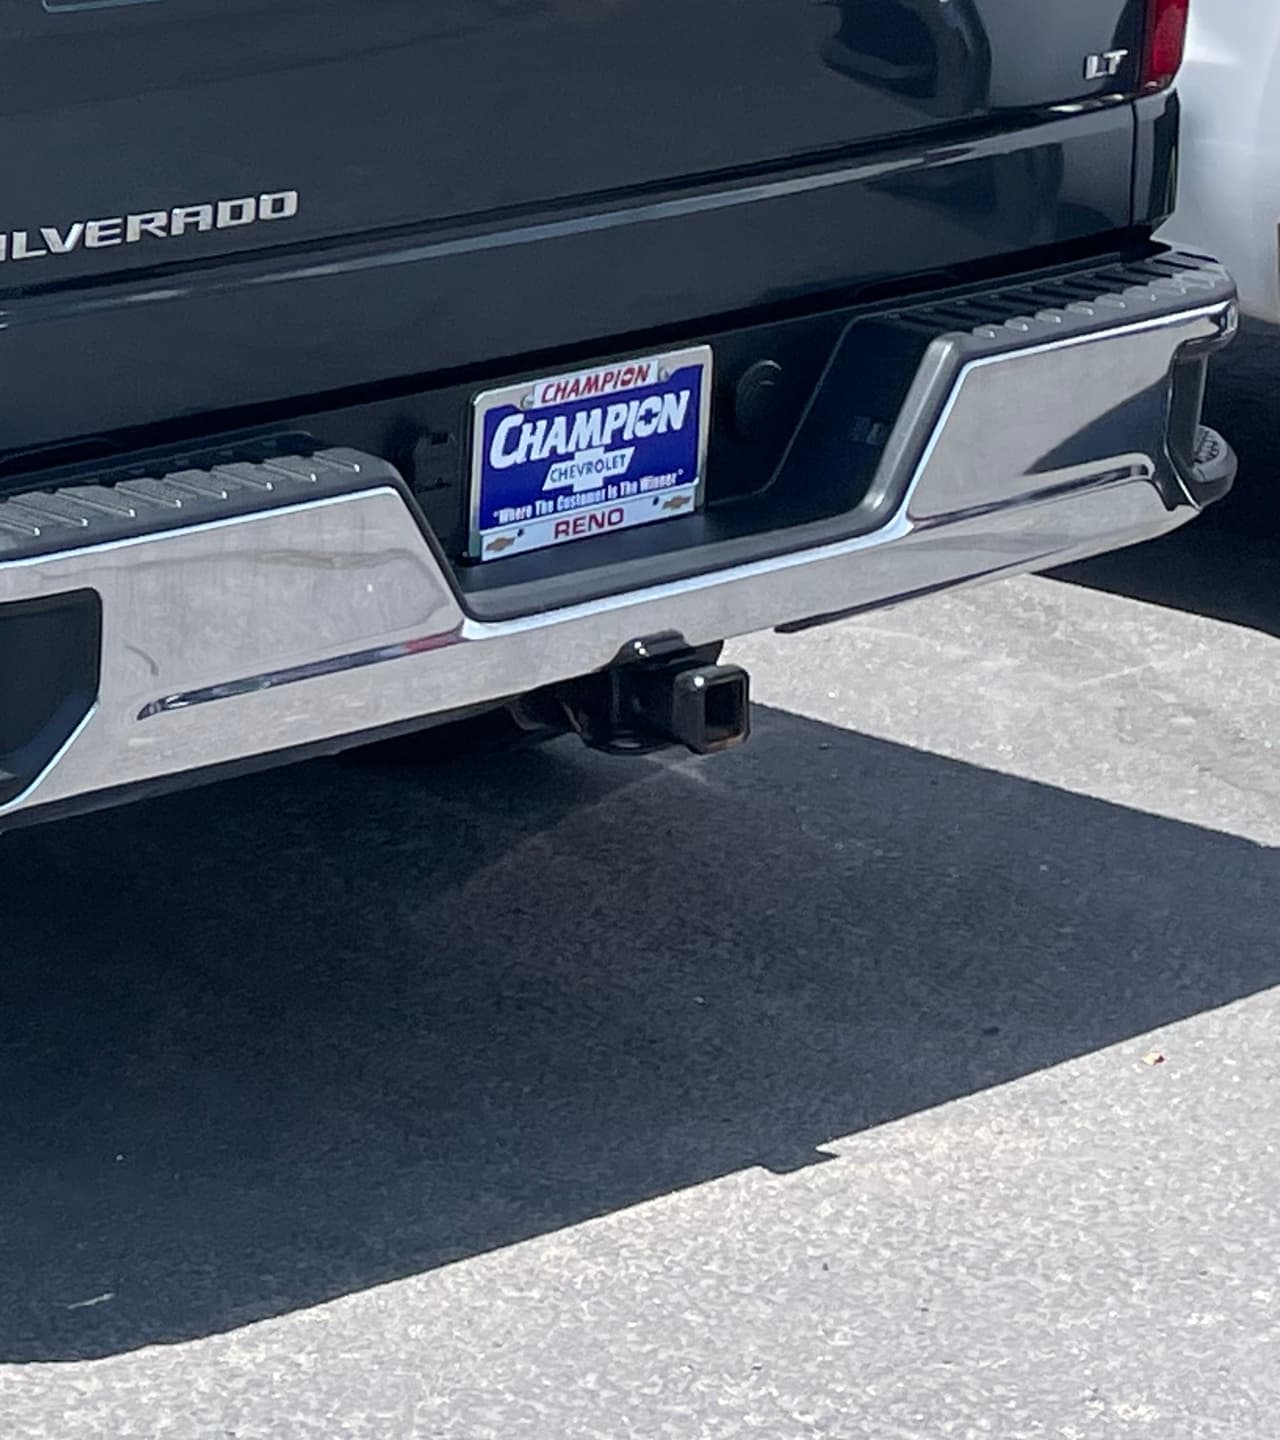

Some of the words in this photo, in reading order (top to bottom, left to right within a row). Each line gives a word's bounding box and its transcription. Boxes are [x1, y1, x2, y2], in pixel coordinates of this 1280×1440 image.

[1085, 49, 1128, 80] LT
[541, 363, 652, 404] CHAMPION
[489, 389, 691, 469] CHAMPION
[549, 453, 627, 484] CHEVROLET
[535, 499, 555, 516] The
[556, 487, 605, 511] Customer
[607, 484, 618, 500] Is
[620, 479, 638, 496] The
[553, 507, 625, 539] RENO
